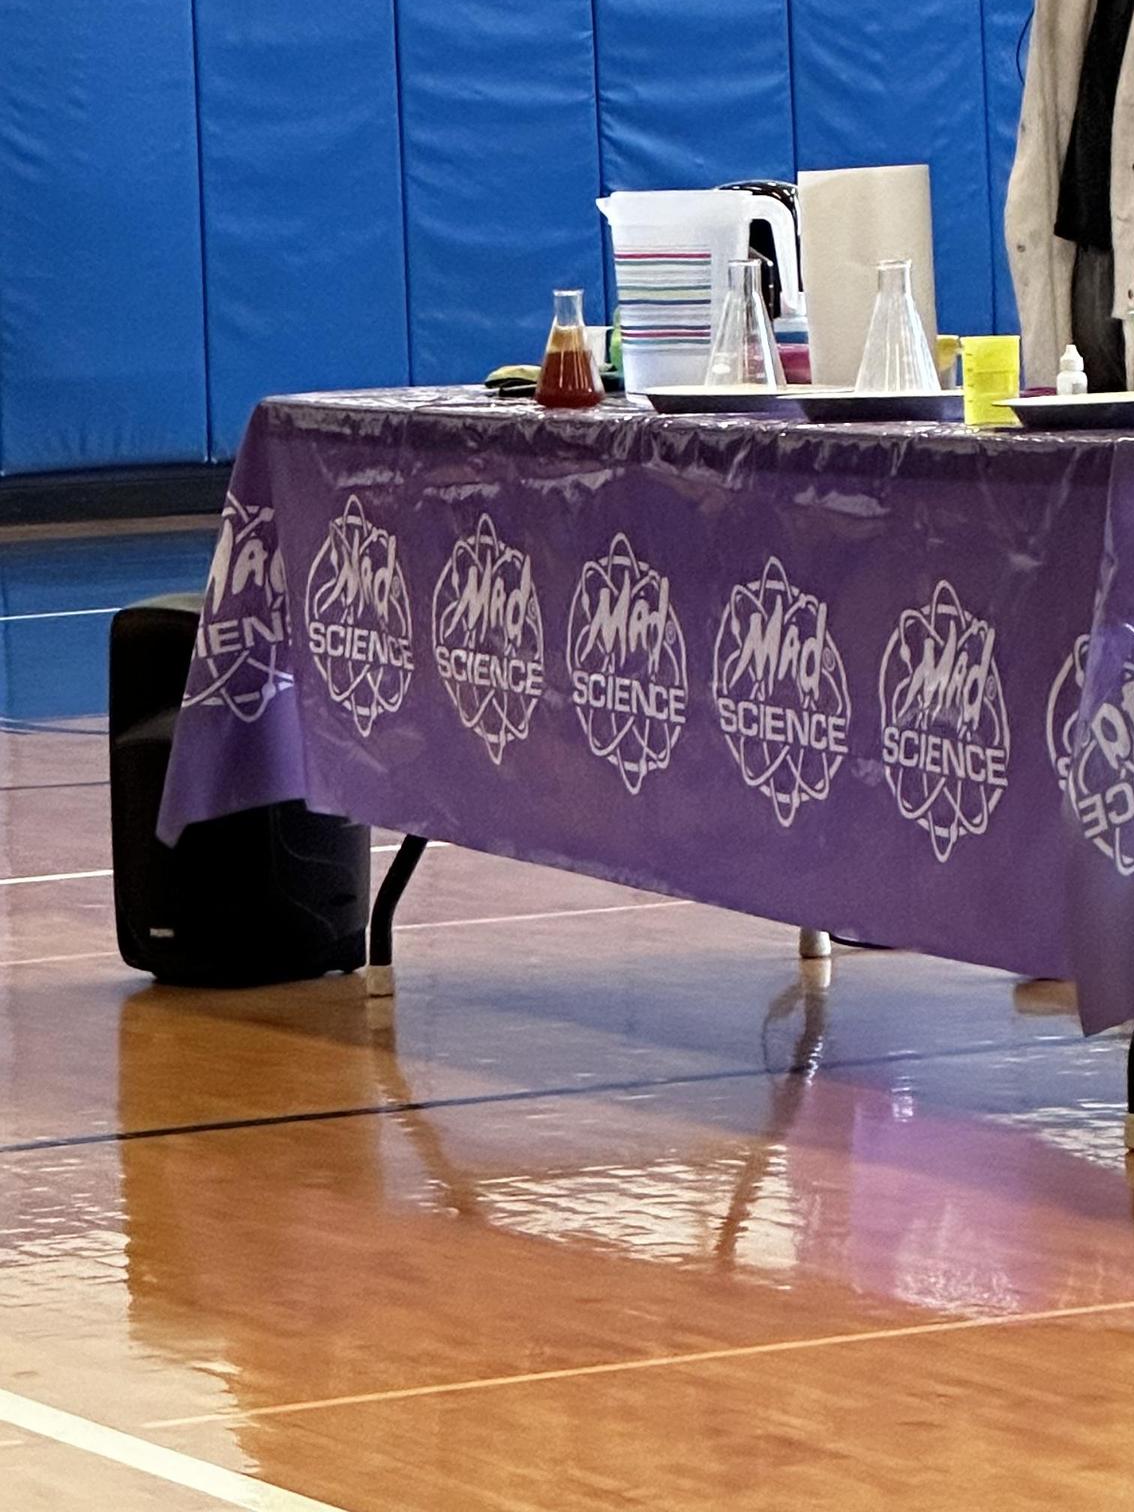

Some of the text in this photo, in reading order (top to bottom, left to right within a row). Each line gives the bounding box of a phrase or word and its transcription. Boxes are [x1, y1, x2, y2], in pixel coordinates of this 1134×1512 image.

[309, 622, 415, 670] SCIENCE
[435, 646, 544, 695] SCIENCE
[573, 670, 687, 723] SCIENCE
[717, 697, 848, 753] SCIENCE
[882, 726, 1008, 786] SCIENCE
